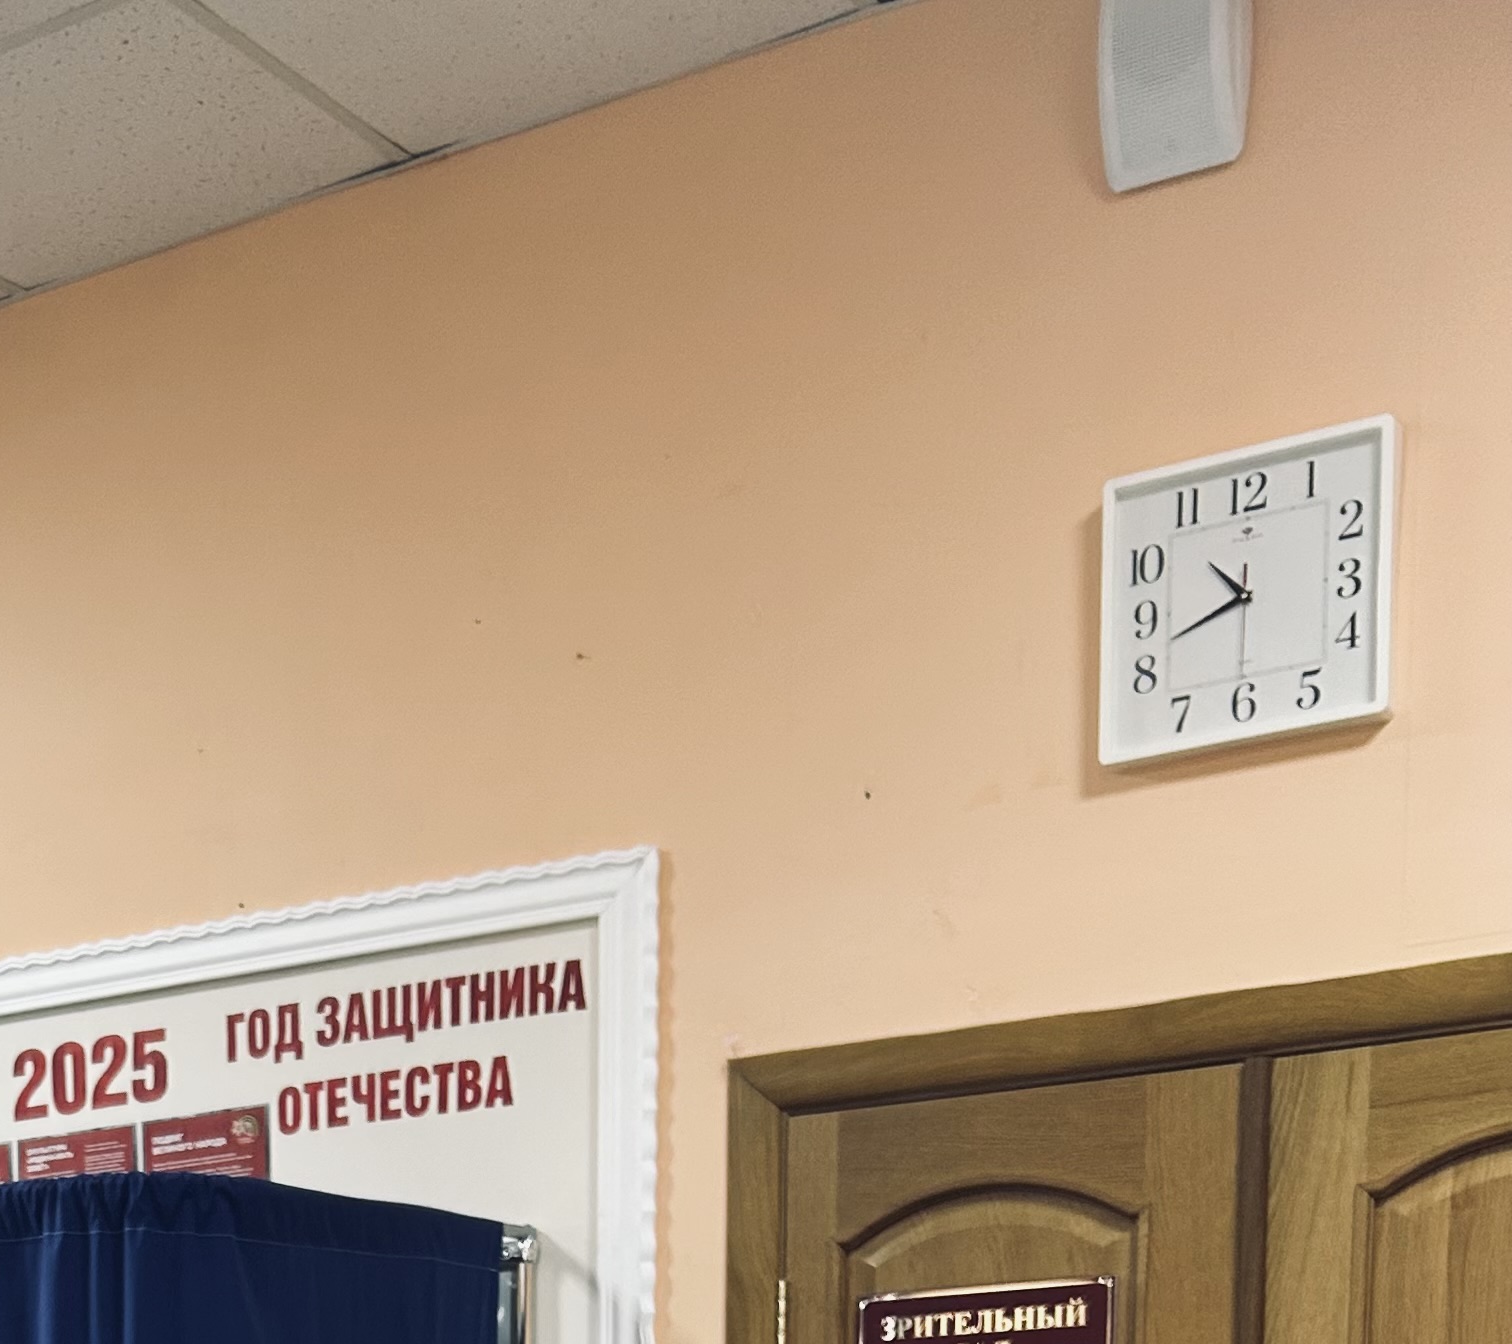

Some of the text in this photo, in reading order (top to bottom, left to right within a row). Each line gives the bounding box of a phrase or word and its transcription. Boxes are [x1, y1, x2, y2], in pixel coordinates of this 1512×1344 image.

[1229, 472, 1268, 516] 12
[1305, 460, 1316, 498] 1
[1175, 487, 1200, 529] 11
[1338, 499, 1364, 541] 2
[1129, 543, 1165, 588] 10
[1336, 557, 1363, 599] 3
[1134, 600, 1159, 640] 9
[1334, 610, 1361, 650] 4
[1133, 654, 1158, 695] 8
[1295, 667, 1323, 710] 5
[1170, 695, 1192, 734] 7
[1231, 681, 1257, 723] 6
[226, 959, 587, 1064] ГОД ЗАЩИТНИКА
[13, 1028, 168, 1122] 2025
[278, 1055, 514, 1136] ОТЕЧЕСТВА
[880, 1297, 1087, 1342] ЗРИТЕЛЬНЫЙ
